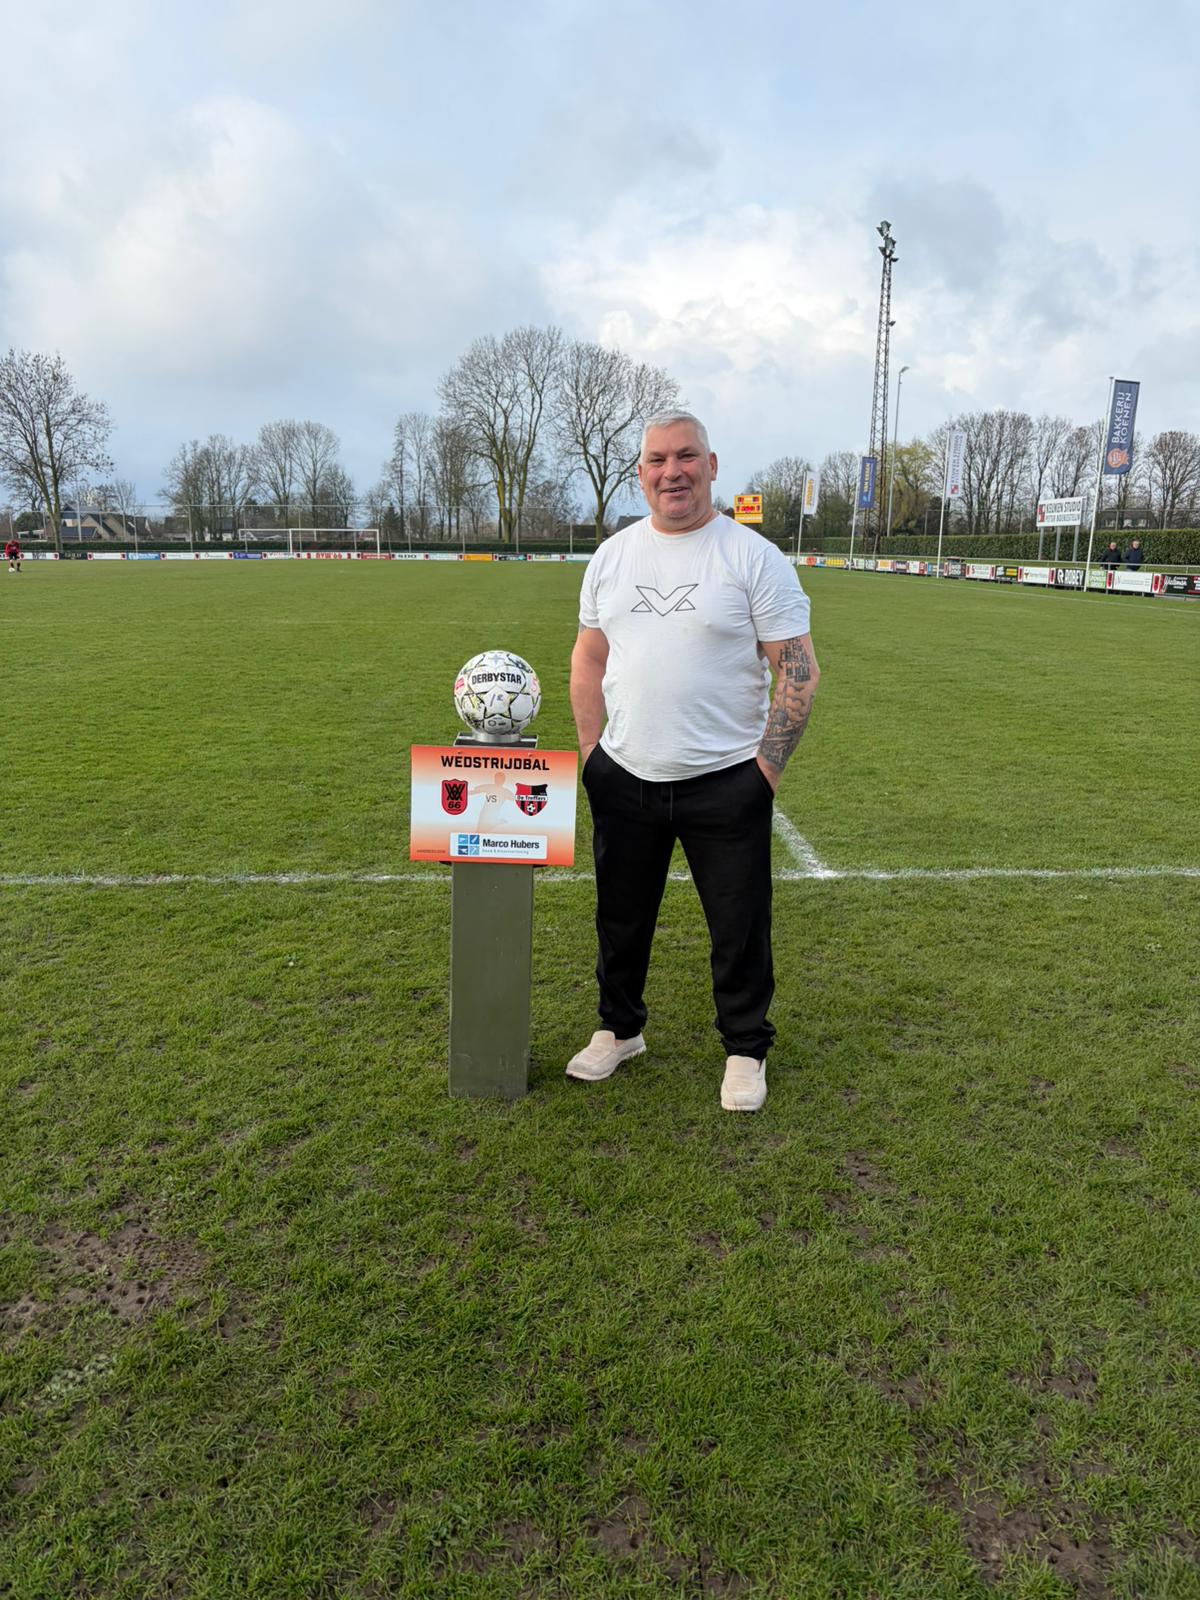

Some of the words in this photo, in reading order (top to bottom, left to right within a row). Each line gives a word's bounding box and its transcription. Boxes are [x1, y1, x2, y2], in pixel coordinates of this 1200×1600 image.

[1111, 391, 1125, 443] BAKKERIJ
[1120, 392, 1132, 444] KOENEN
[1064, 569, 1084, 586] ROBEY
[471, 672, 522, 685] DERBYSTAR
[441, 755, 550, 771] WEDSTRIJDBAL
[448, 801, 462, 809] 66
[482, 838, 509, 848] Marco
[510, 839, 540, 849] Hubers
